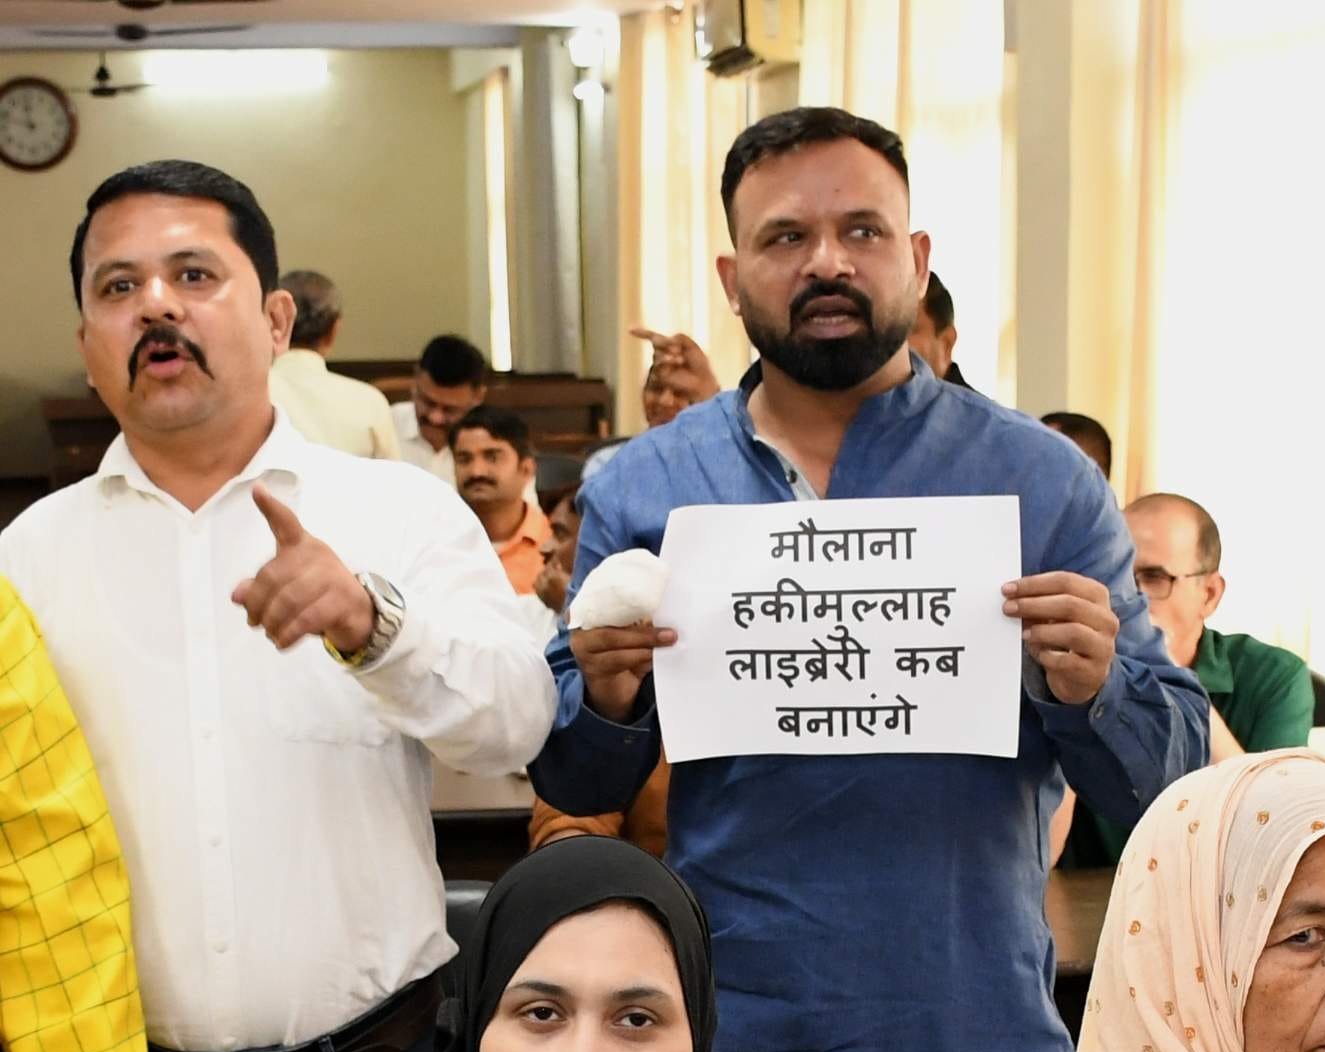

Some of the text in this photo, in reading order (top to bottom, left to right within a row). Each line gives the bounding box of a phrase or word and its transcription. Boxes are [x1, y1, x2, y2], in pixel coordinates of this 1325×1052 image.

[770, 518, 917, 562] मौलाना
[731, 577, 956, 641] हकीमुल्लाह
[726, 637, 965, 688] लाइब्रेरी कब
[776, 693, 917, 738] बनाएंगे
